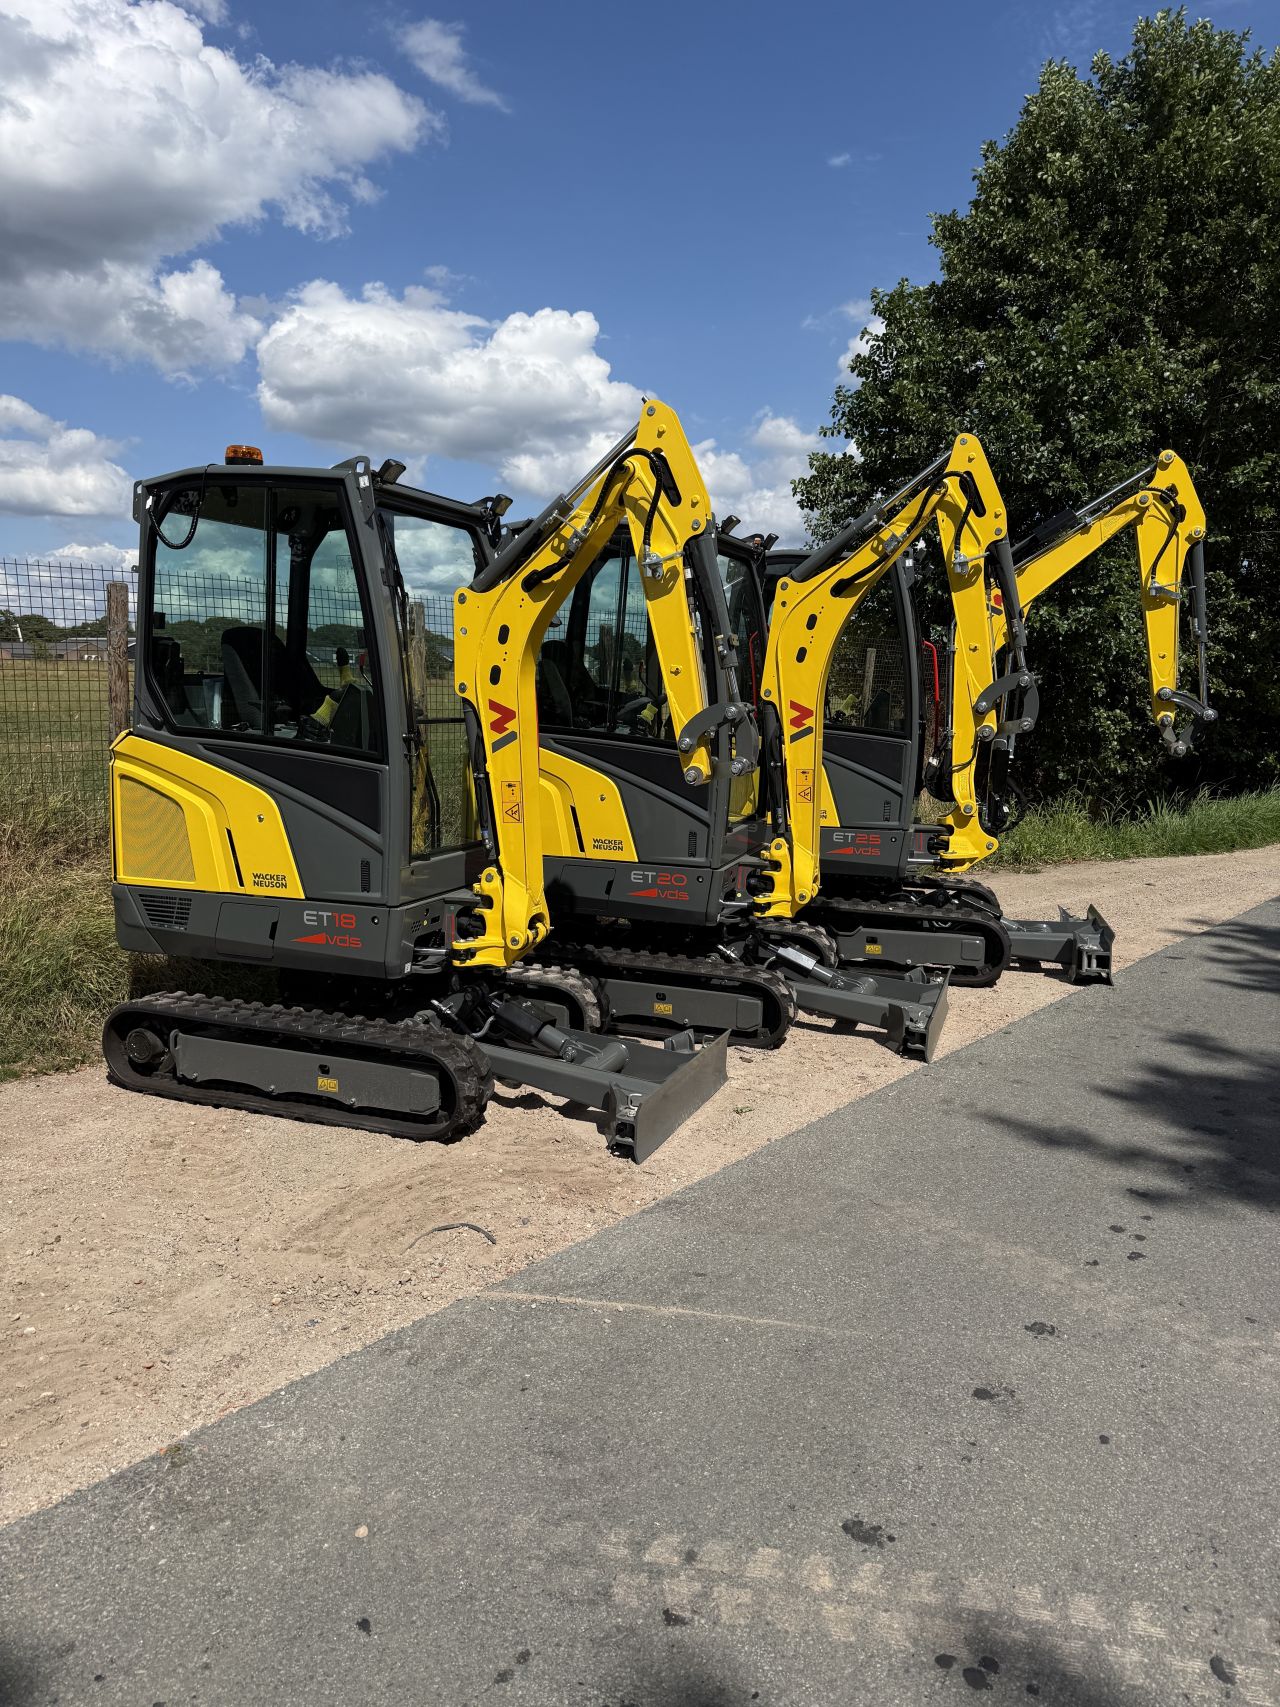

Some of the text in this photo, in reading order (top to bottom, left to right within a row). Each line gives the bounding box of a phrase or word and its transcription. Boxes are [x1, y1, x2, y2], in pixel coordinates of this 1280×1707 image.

[592, 838, 624, 847] WACKER
[833, 832, 881, 845] ET25
[592, 844, 624, 852] NEUSON
[854, 847, 881, 856] vds
[252, 872, 287, 882] WACKER
[630, 870, 688, 886] ET20
[253, 880, 288, 889] NEUSON
[658, 889, 689, 901] vds
[303, 910, 357, 929] ET18
[325, 934, 362, 949] vds
